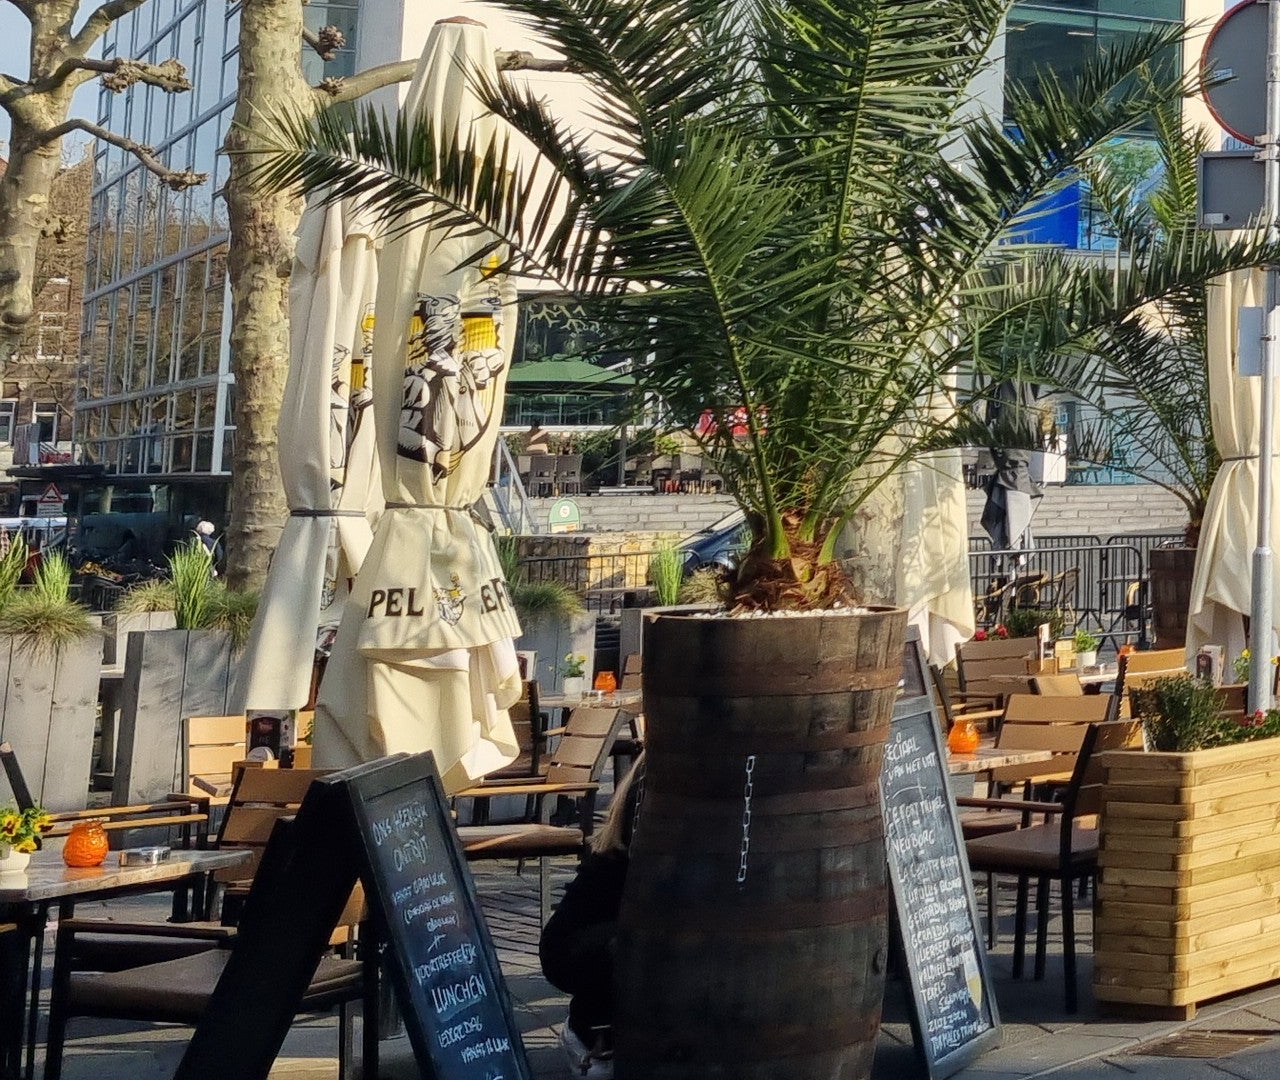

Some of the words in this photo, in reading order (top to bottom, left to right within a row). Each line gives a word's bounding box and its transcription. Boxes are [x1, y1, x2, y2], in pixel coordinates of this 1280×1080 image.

[905, 757, 921, 775] HET
[921, 751, 936, 768] VAT
[372, 817, 392, 846] ONS
[415, 943, 477, 986] VOORTREFFELIJK
[431, 973, 488, 1013] LUNCHEN
